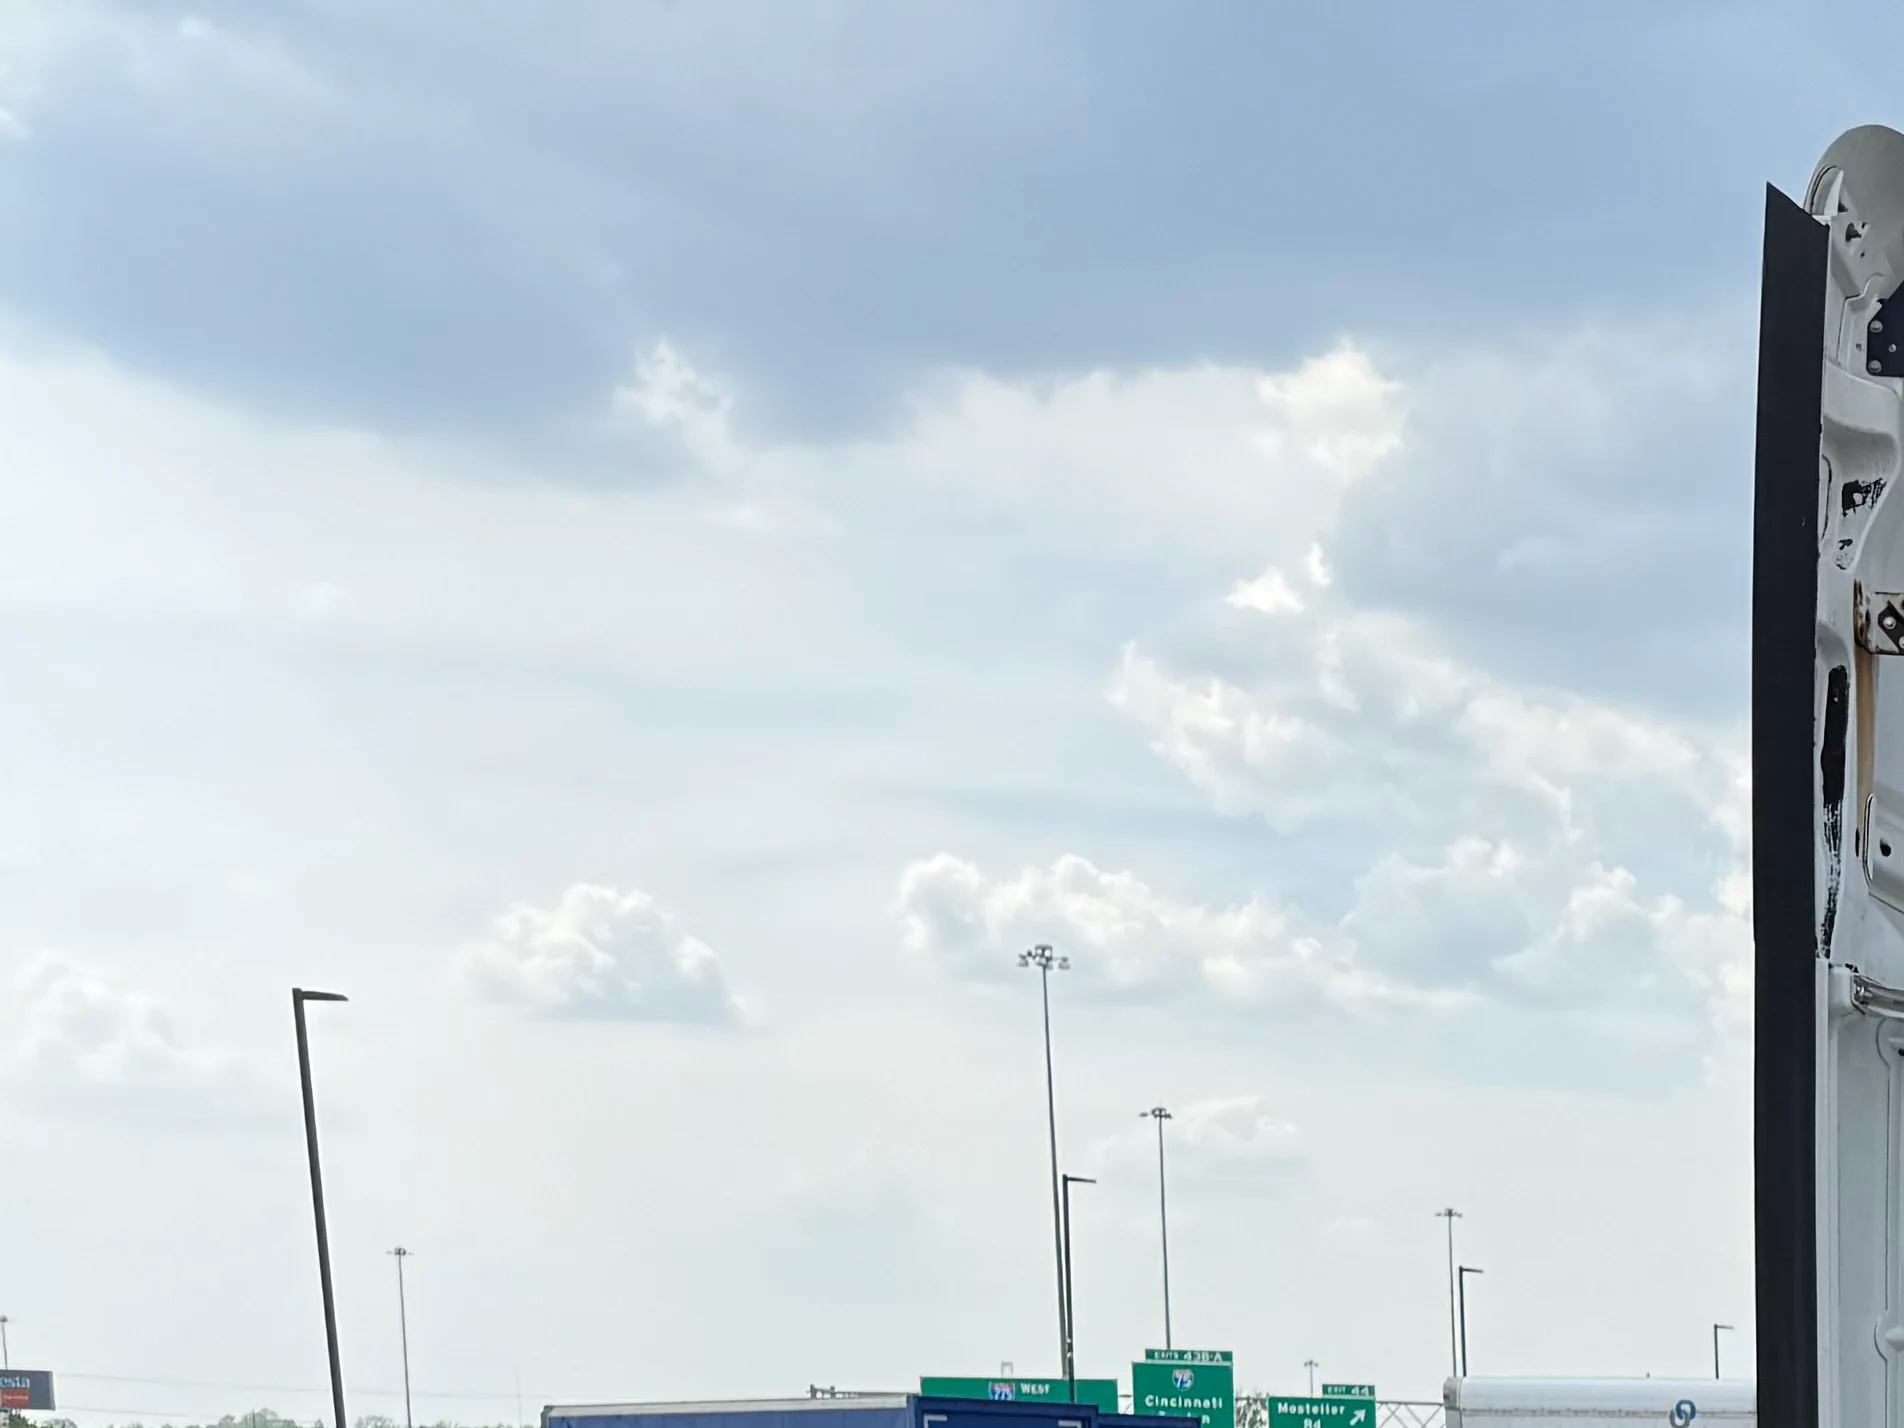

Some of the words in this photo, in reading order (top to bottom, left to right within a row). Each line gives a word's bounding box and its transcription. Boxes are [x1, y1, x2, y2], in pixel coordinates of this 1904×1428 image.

[1020, 1382, 1050, 1395] WEST
[1145, 1394, 1223, 1410] Cincinnati
[1277, 1402, 1345, 1416] Mosteller
